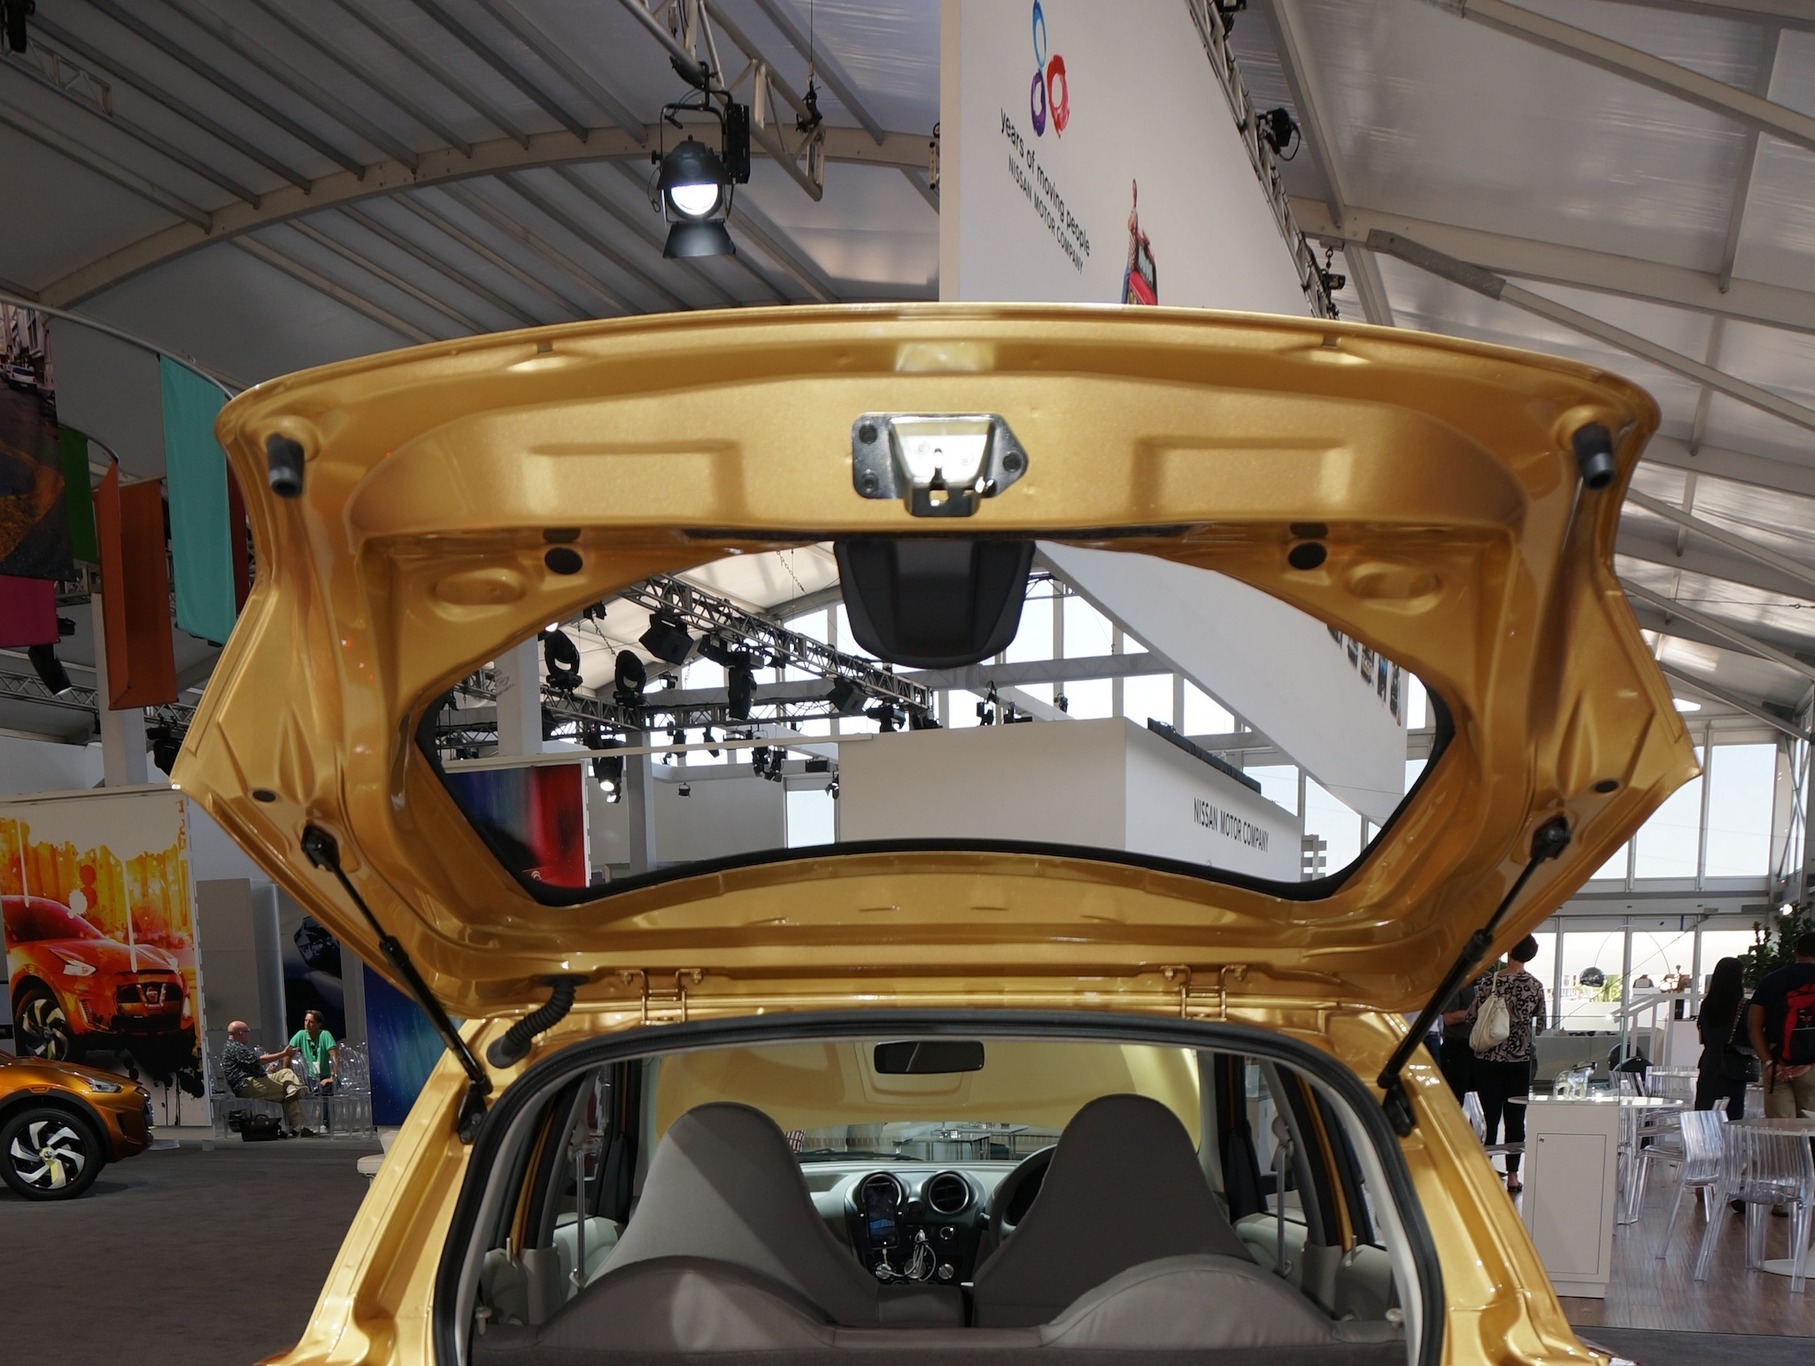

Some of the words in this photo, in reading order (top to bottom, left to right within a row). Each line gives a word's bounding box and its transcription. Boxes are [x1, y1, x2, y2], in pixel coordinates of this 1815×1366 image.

[1001, 107, 1025, 158] years
[1026, 150, 1036, 174] of
[1036, 163, 1065, 222] moving
[1066, 208, 1091, 257] people
[1008, 153, 1033, 203] NISSAN
[1033, 191, 1056, 237] MOTOR
[1056, 226, 1084, 275] COMPANY
[1193, 797, 1218, 832] NISSAN
[1219, 809, 1242, 843] MOTOR
[1242, 821, 1270, 853] COMPANY
